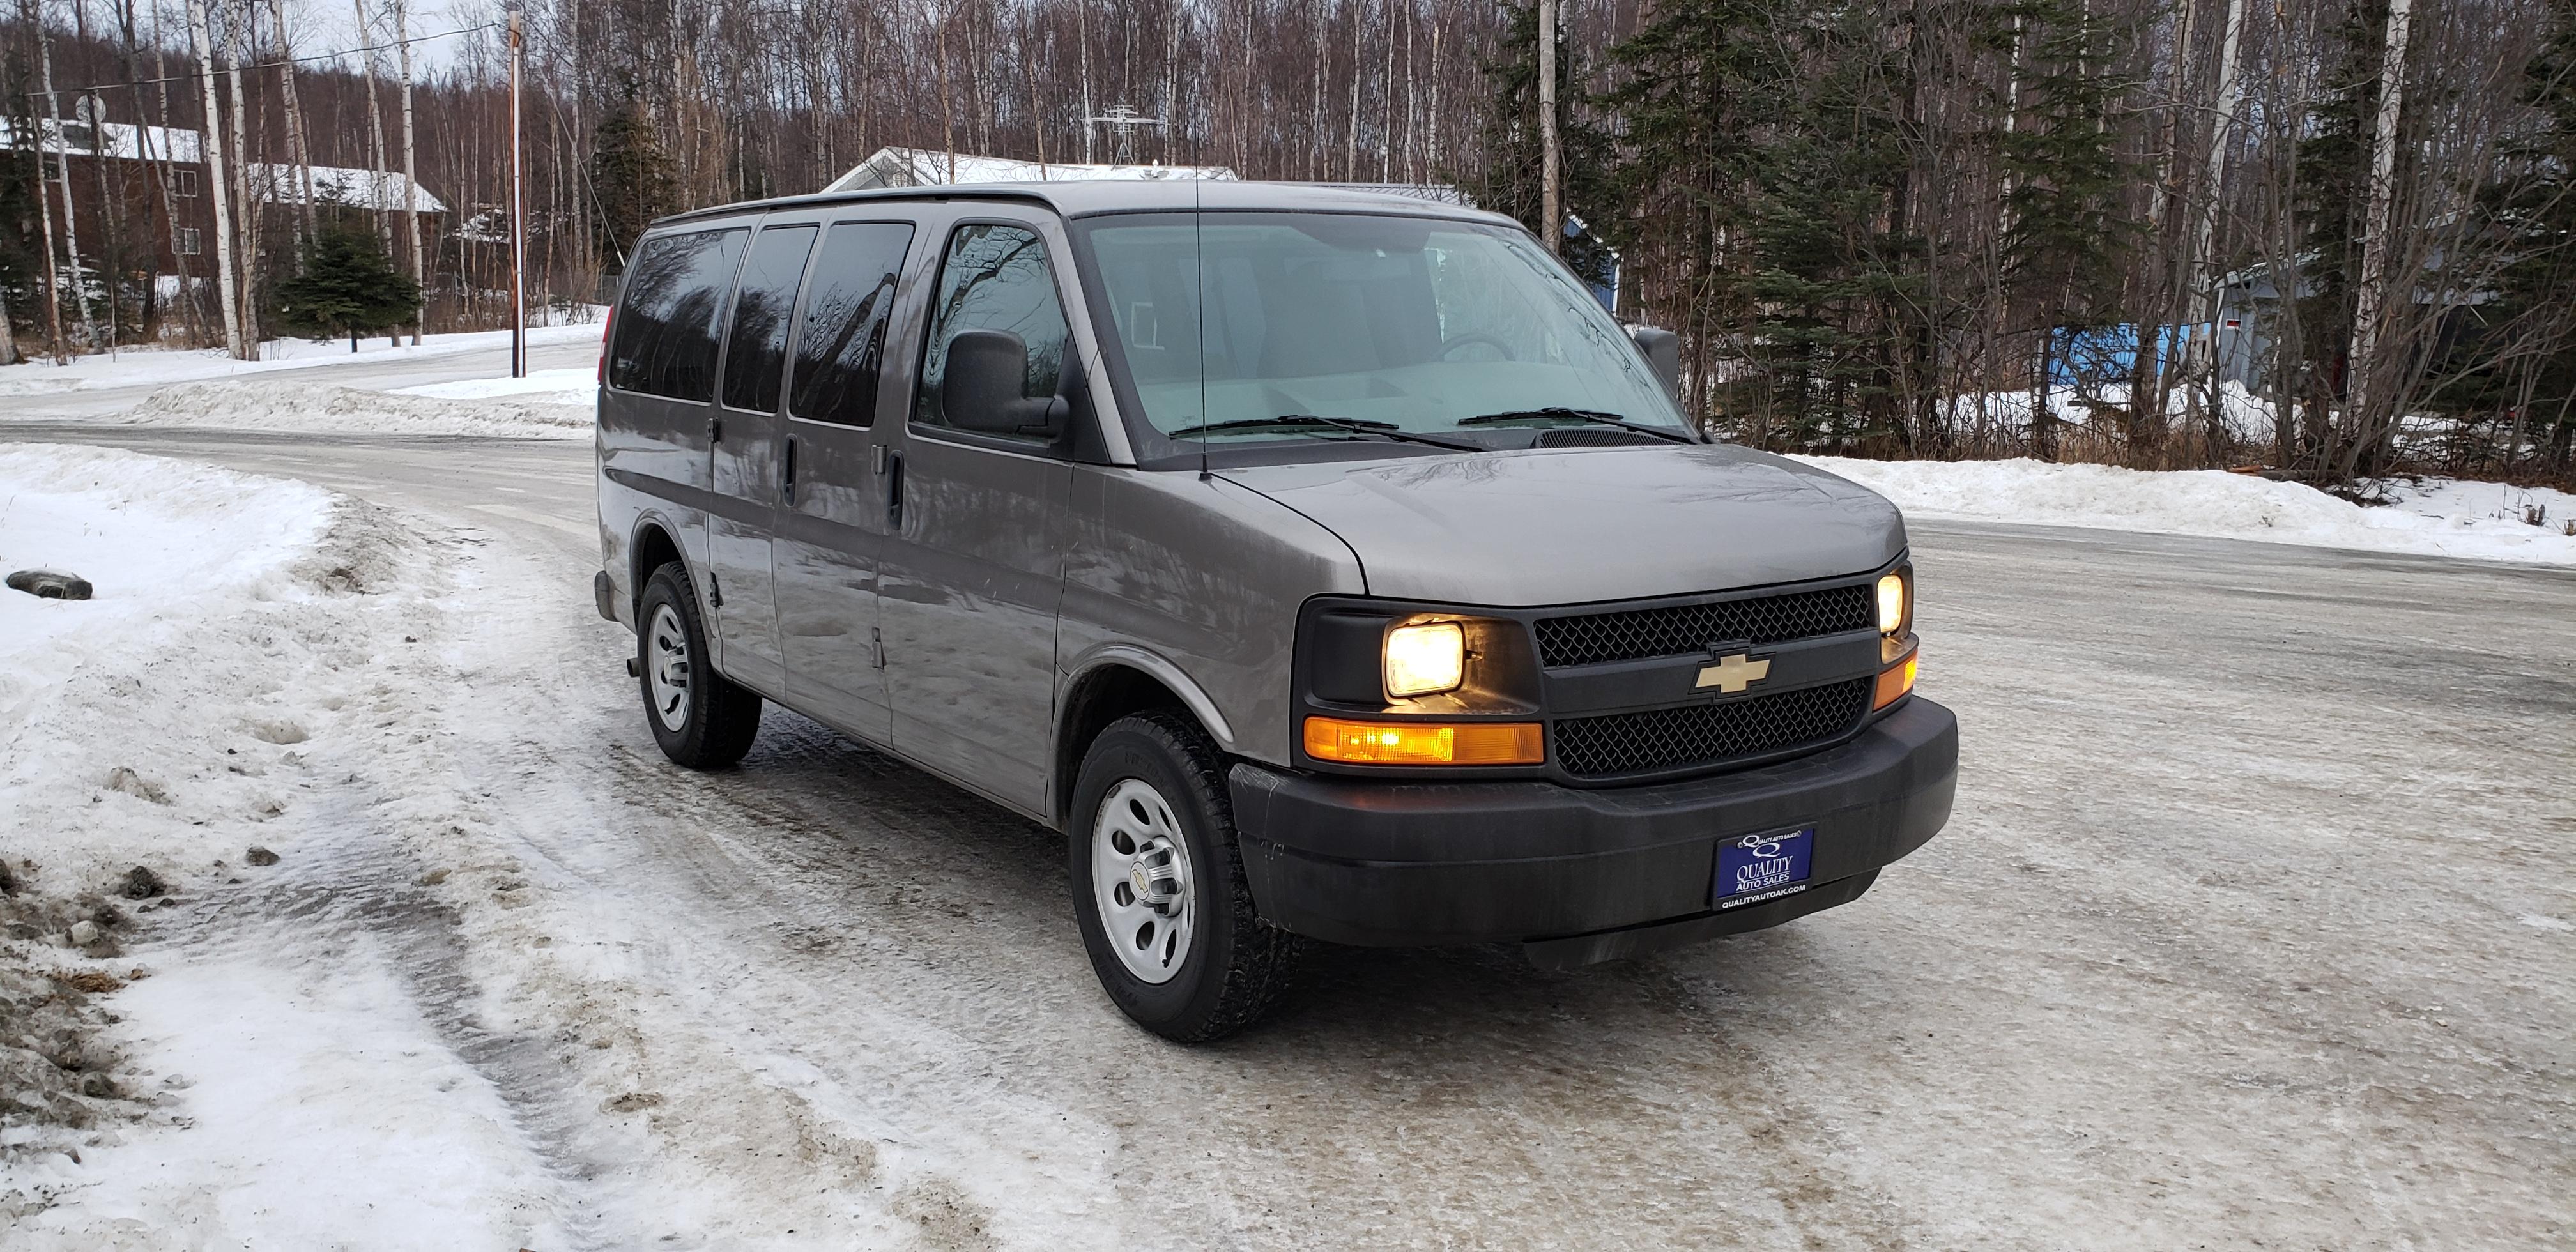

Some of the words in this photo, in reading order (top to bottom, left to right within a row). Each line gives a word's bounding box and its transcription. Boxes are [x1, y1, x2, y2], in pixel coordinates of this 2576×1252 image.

[1742, 834, 1773, 848] QUALITY
[1736, 855, 1793, 884] QUALITY
[1736, 880, 1761, 891] AUTO
[1763, 873, 1789, 886] SALES
[1722, 884, 1806, 909] QUALITYAUTOAK.COM
